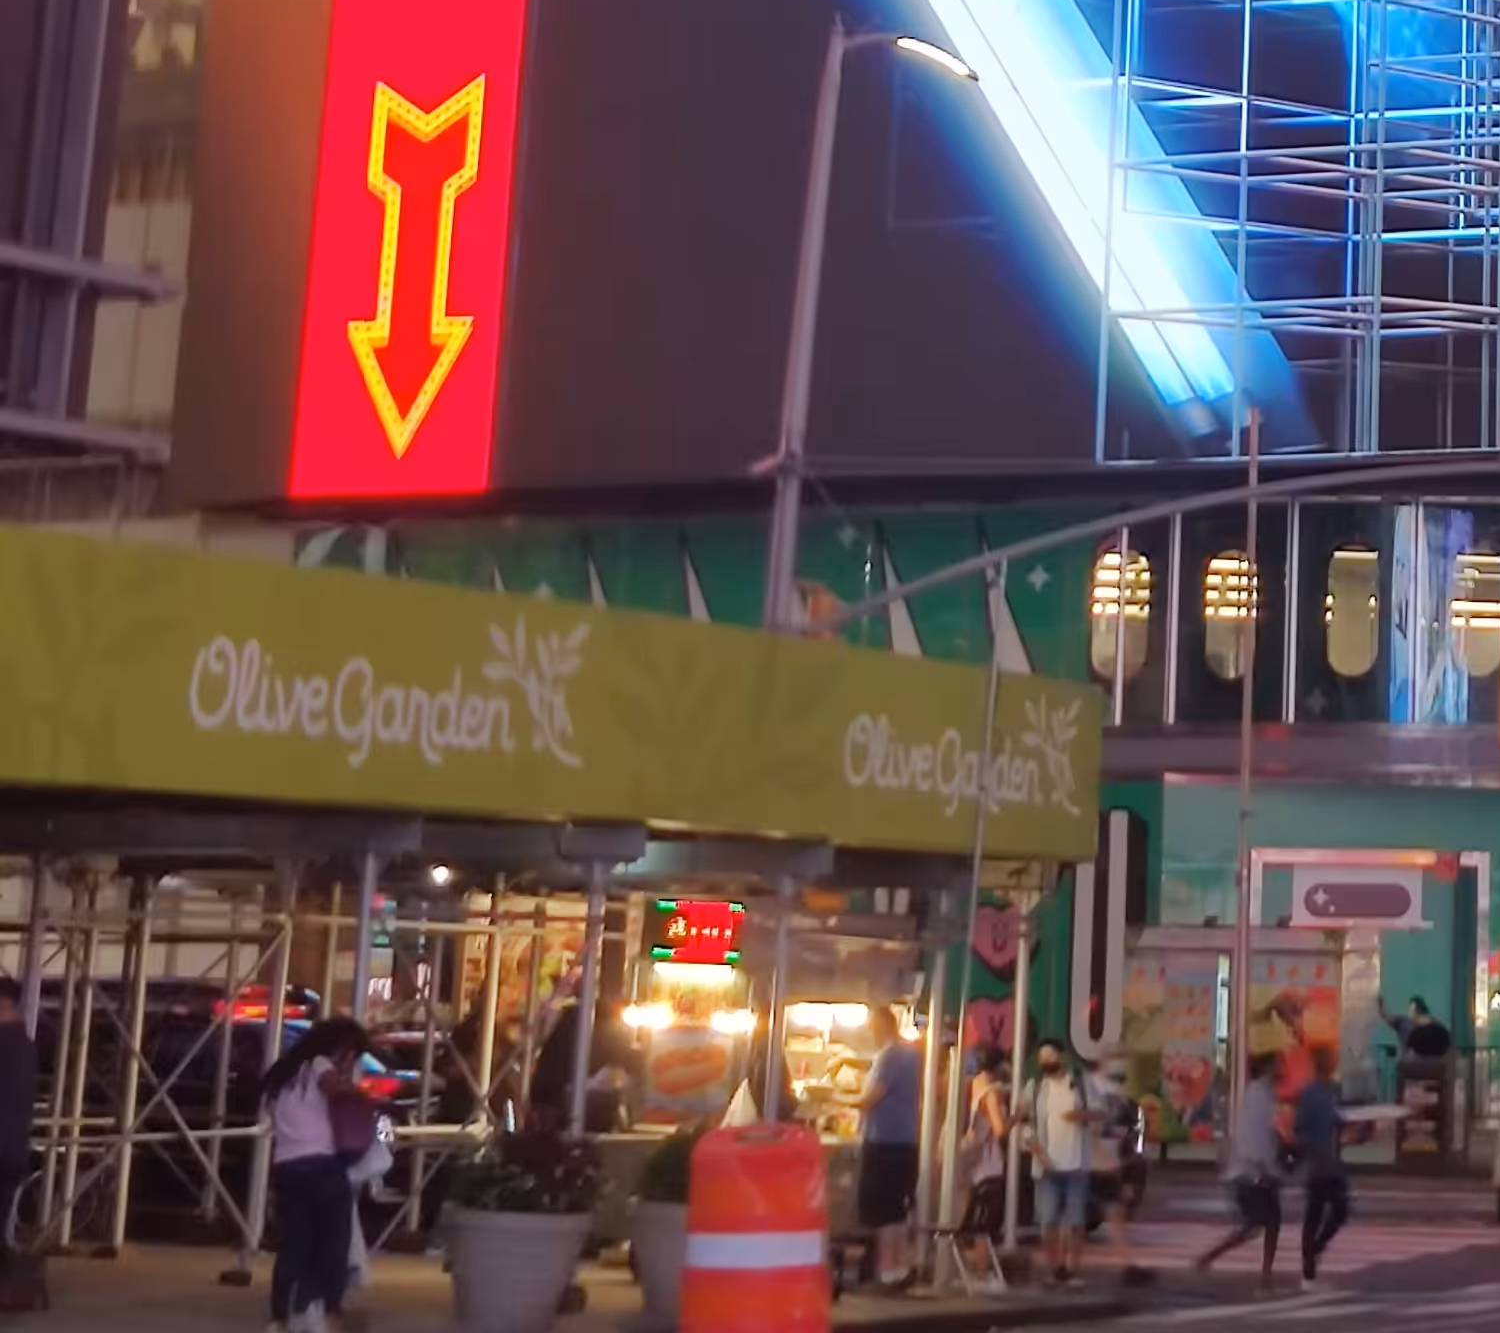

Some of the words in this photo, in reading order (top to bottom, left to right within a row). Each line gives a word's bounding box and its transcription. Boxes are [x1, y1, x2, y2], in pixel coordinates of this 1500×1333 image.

[188, 634, 331, 739] Olive
[333, 655, 516, 769] Garden
[845, 712, 934, 792] Olive
